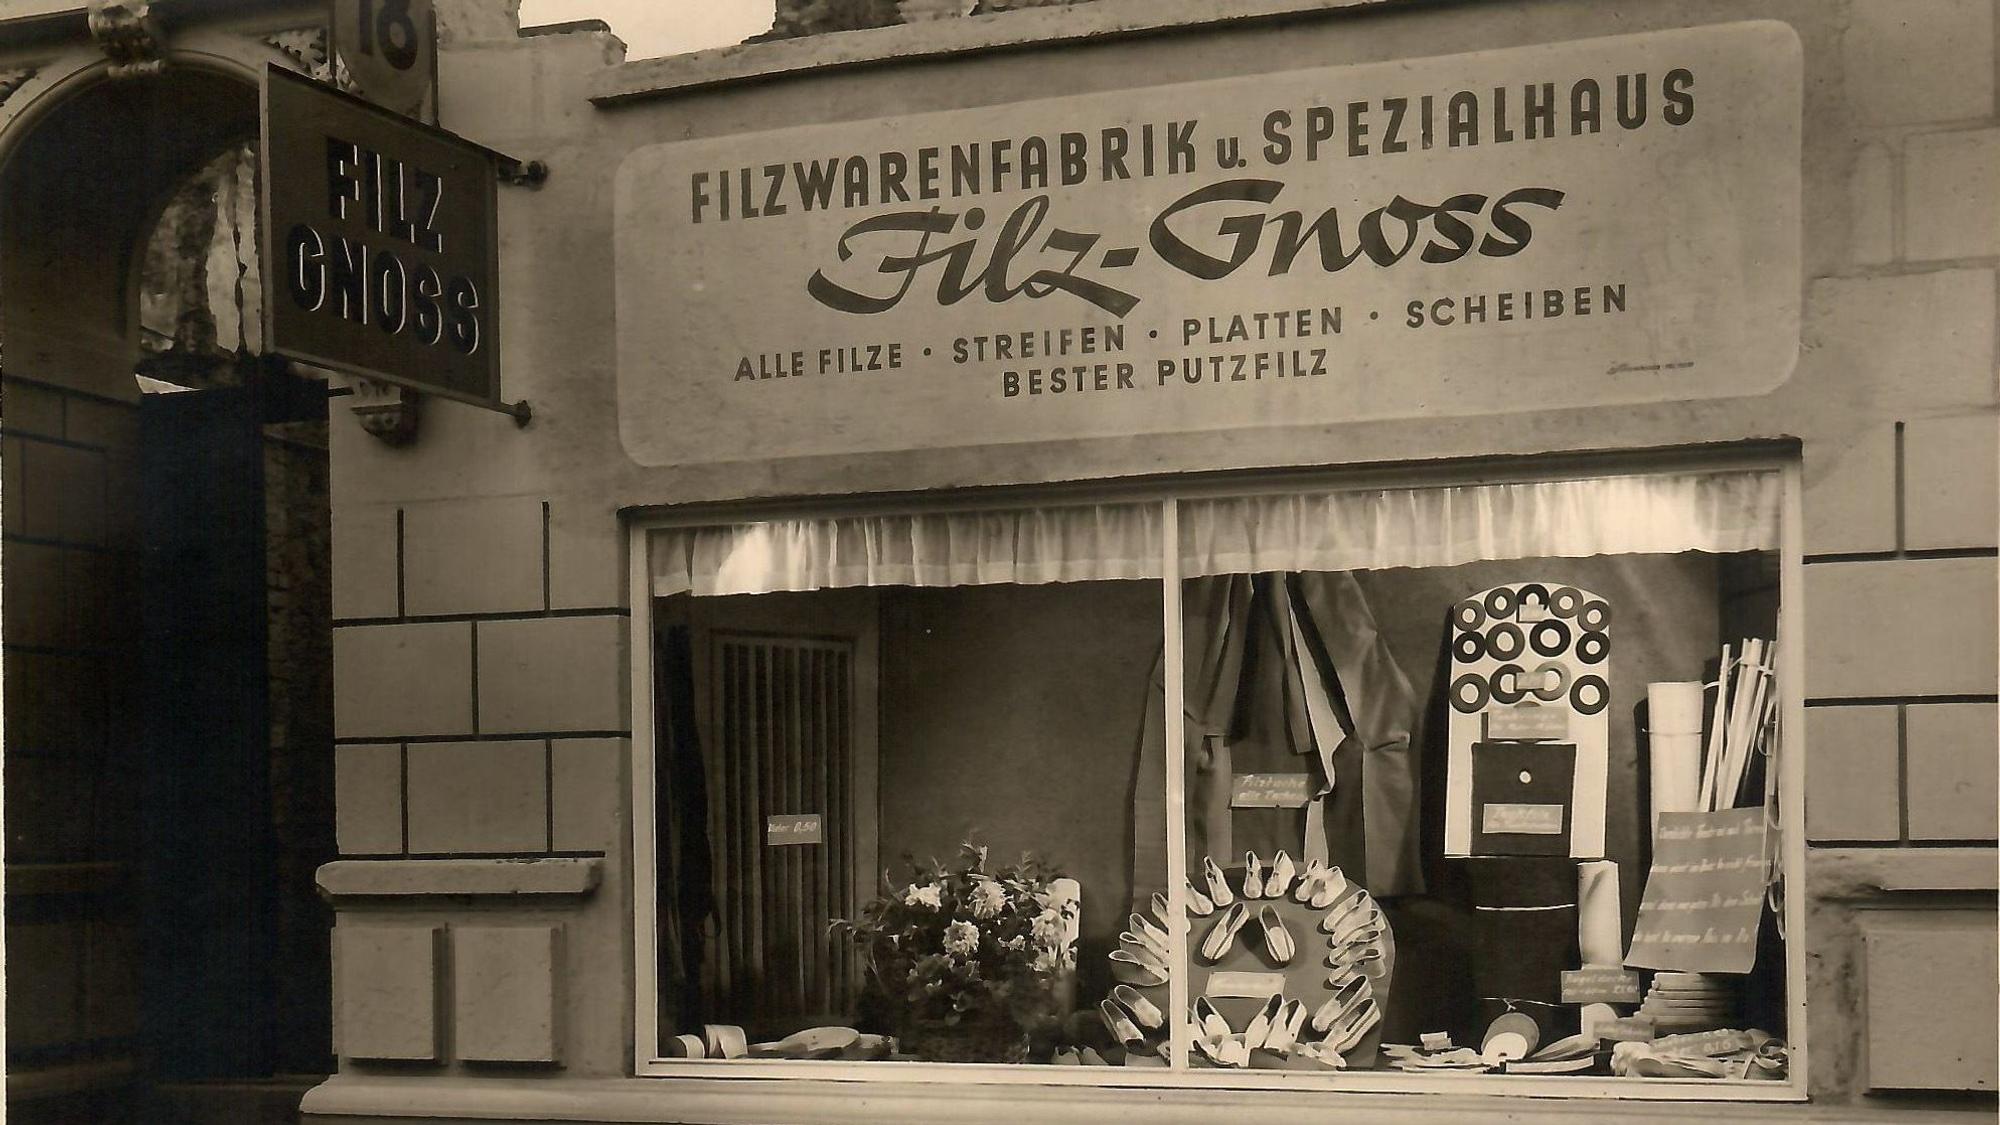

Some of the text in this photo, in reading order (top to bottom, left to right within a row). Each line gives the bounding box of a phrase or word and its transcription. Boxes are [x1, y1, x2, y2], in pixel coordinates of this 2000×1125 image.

[358, 0, 419, 71] 16
[327, 138, 443, 254] FILZ
[691, 68, 1695, 224] FILZWARENFABRIK u. SPEZIALHAUS
[287, 223, 480, 356] GNOSS
[807, 178, 1566, 319] Filz-Gnoss
[734, 284, 1627, 382] ALLE FILZE STREIFEN PLATTEN SCHEIBEN
[1003, 348, 1328, 398] BESTER PUTZFILZ
